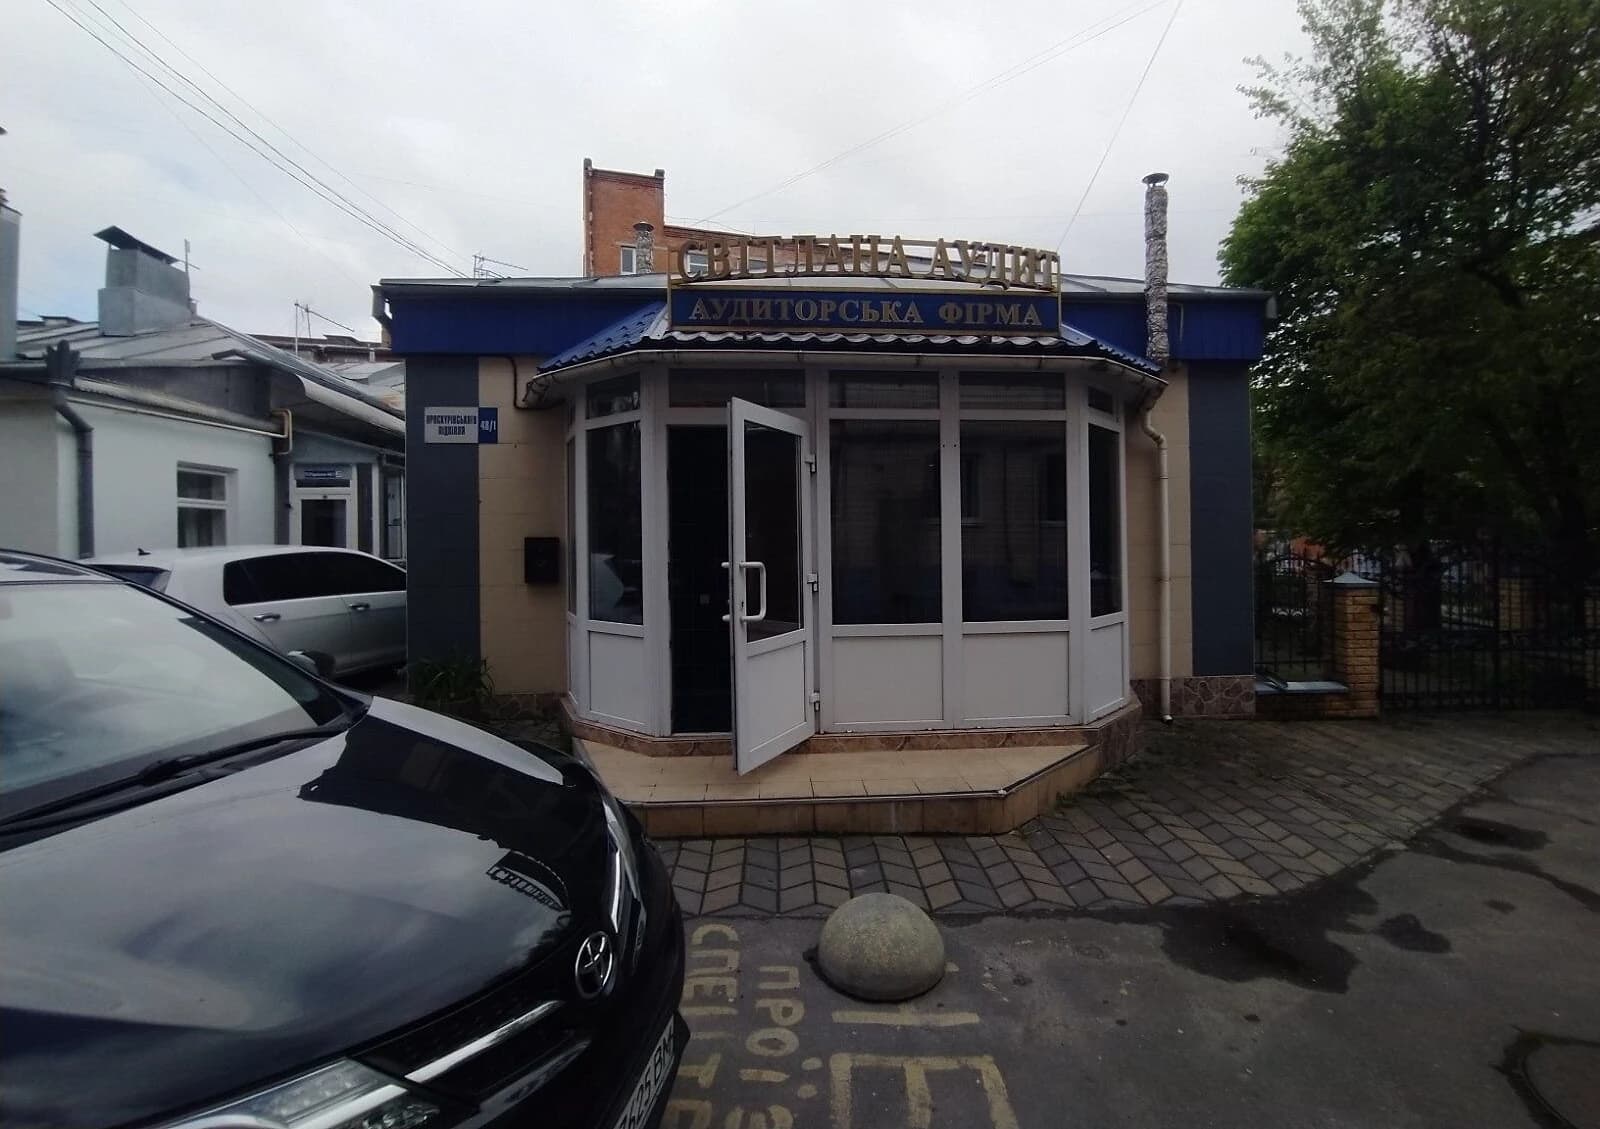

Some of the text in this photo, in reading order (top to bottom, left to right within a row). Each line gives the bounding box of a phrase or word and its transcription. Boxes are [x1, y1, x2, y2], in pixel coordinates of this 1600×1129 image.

[677, 233, 1059, 291] СВІТЛАНА АУДИТ
[688, 296, 1043, 326] АУДИТОРСЬКА ФІРМА
